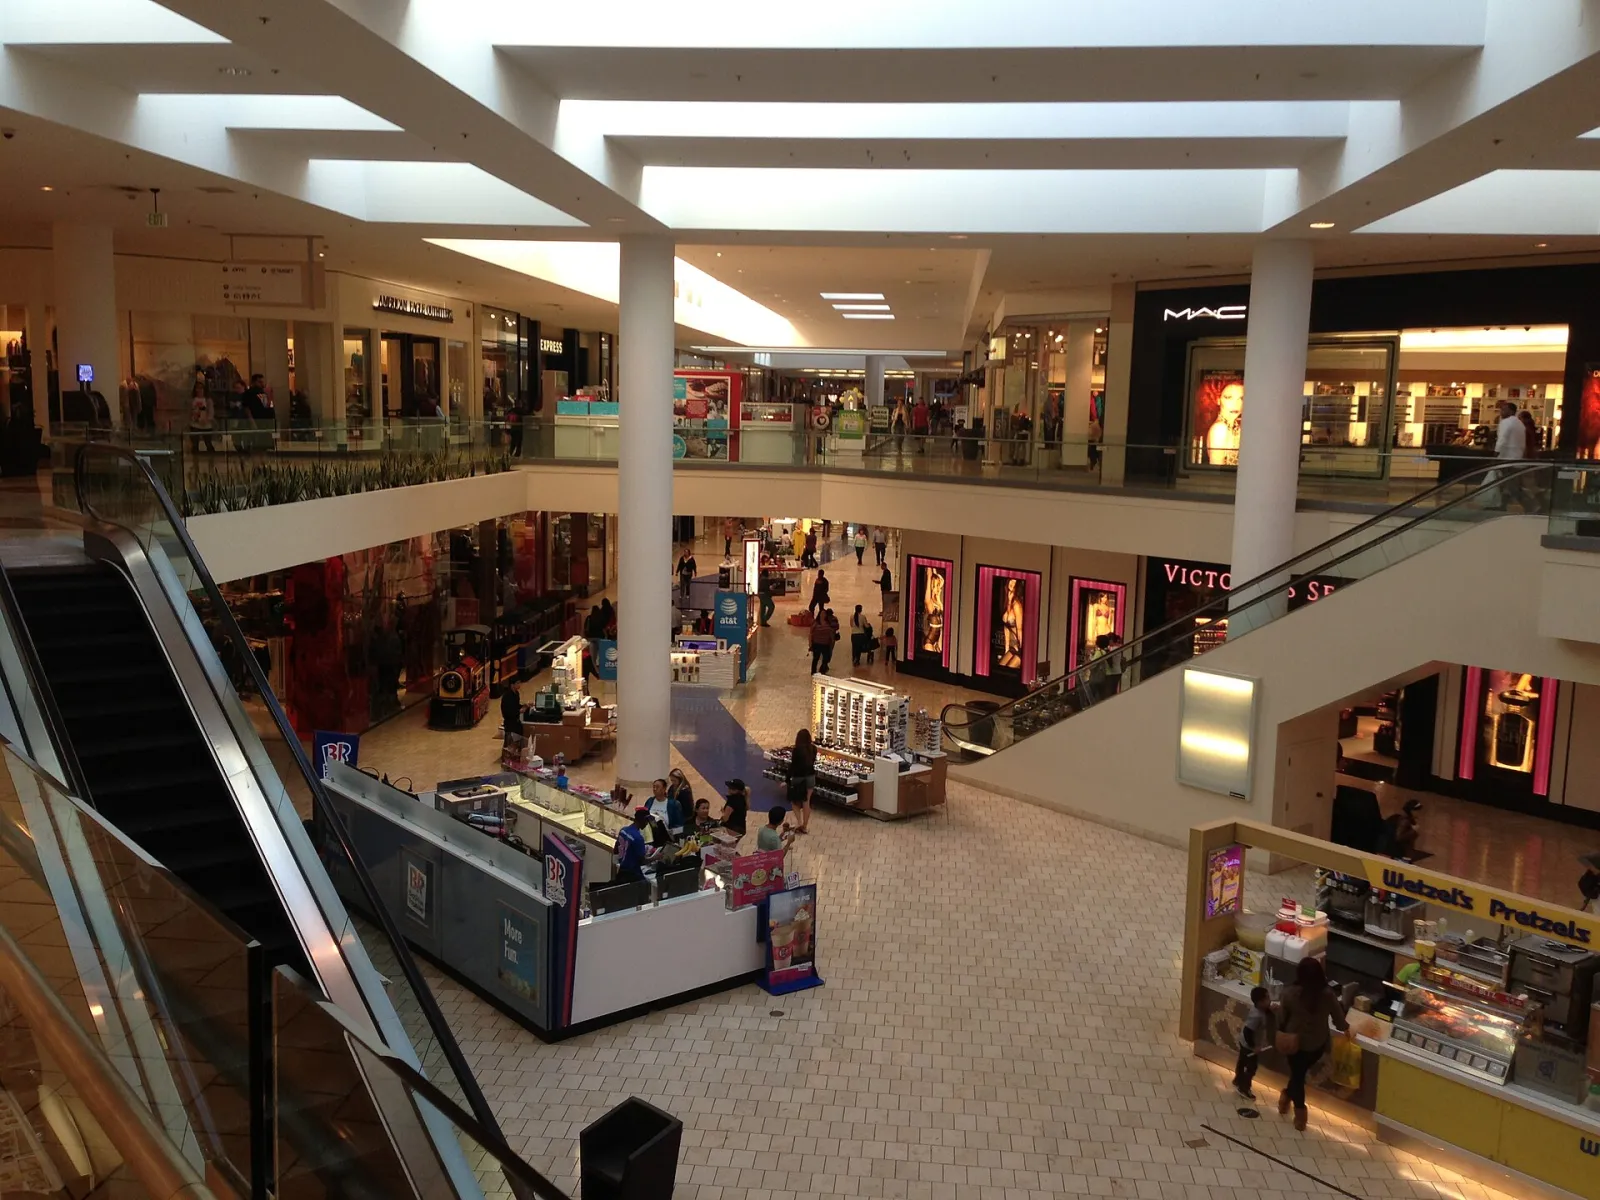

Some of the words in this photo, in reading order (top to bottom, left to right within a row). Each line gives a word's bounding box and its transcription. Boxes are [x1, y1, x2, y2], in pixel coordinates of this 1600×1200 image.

[540, 338, 563, 354] EXPRESS
[1382, 868, 1475, 910] Wetzel's
[1489, 898, 1591, 943] Pretzels
[504, 918, 523, 944] More
